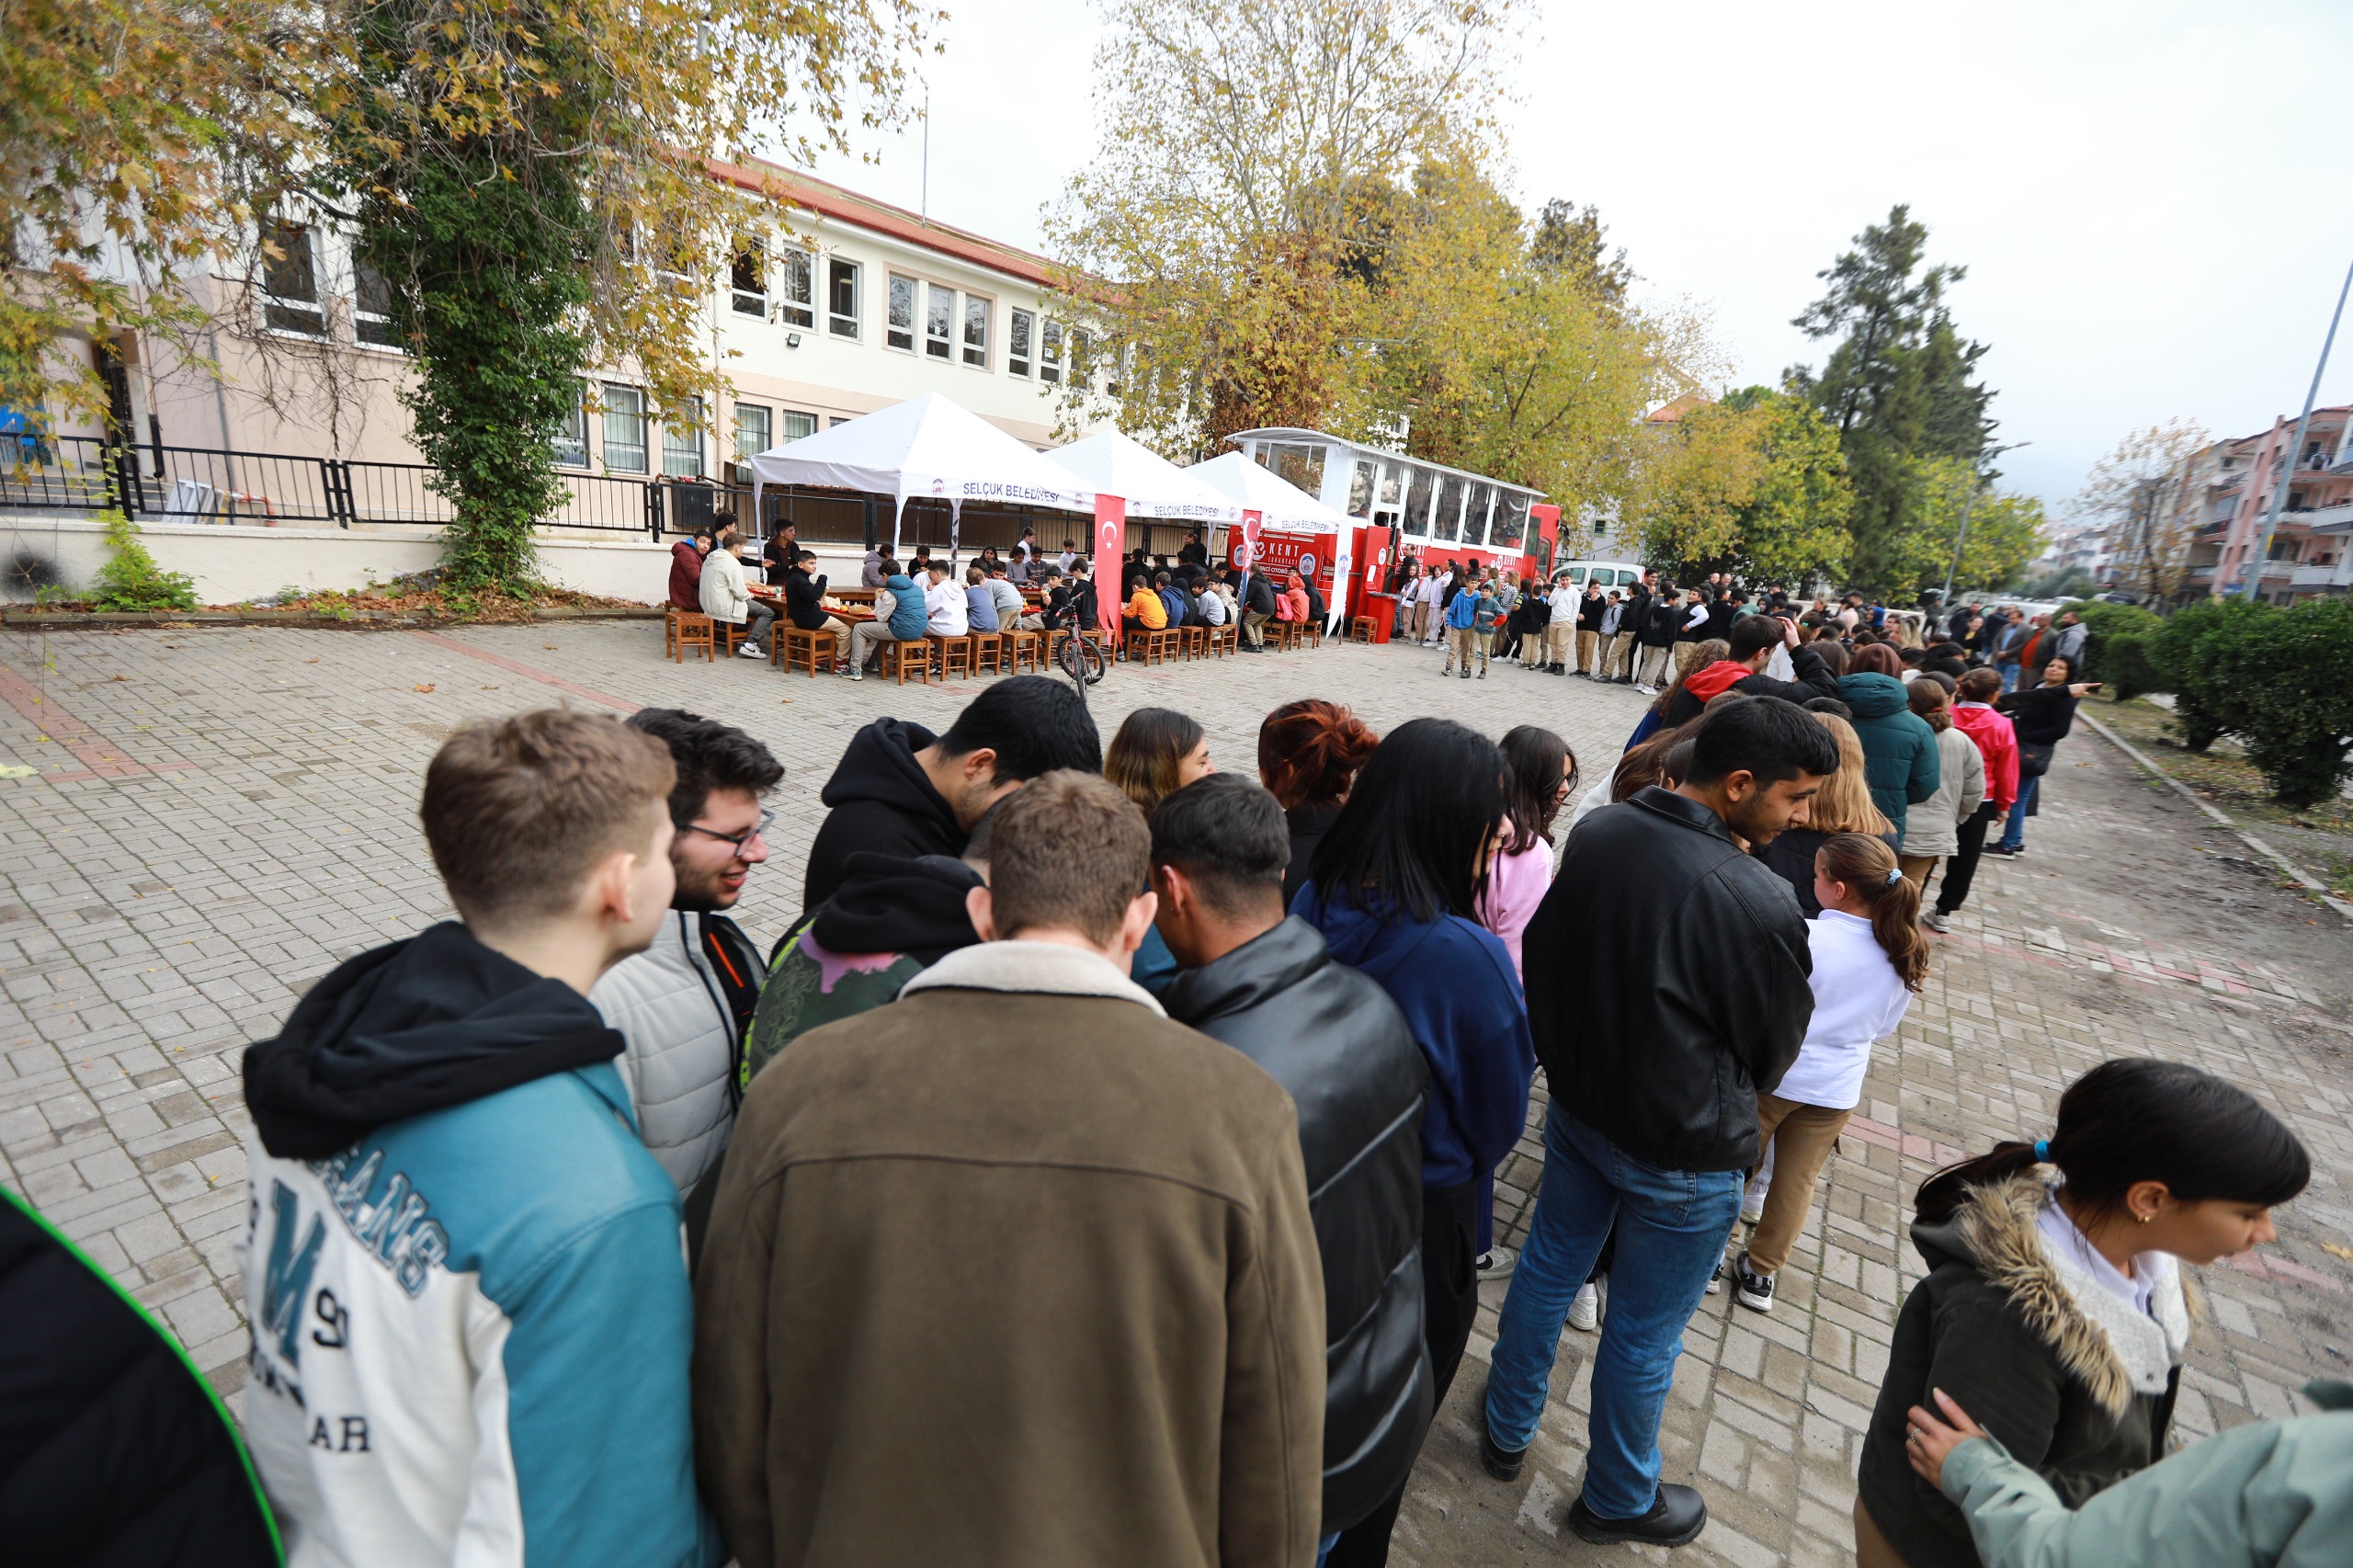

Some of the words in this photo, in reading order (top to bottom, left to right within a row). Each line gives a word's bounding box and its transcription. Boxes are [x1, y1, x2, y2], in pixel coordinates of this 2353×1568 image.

[963, 483, 1003, 497] SELÇUK
[1006, 484, 1059, 503] BELEDİYESİ
[1154, 506, 1181, 517] SELÇUK
[1269, 543, 1299, 557] KENT
